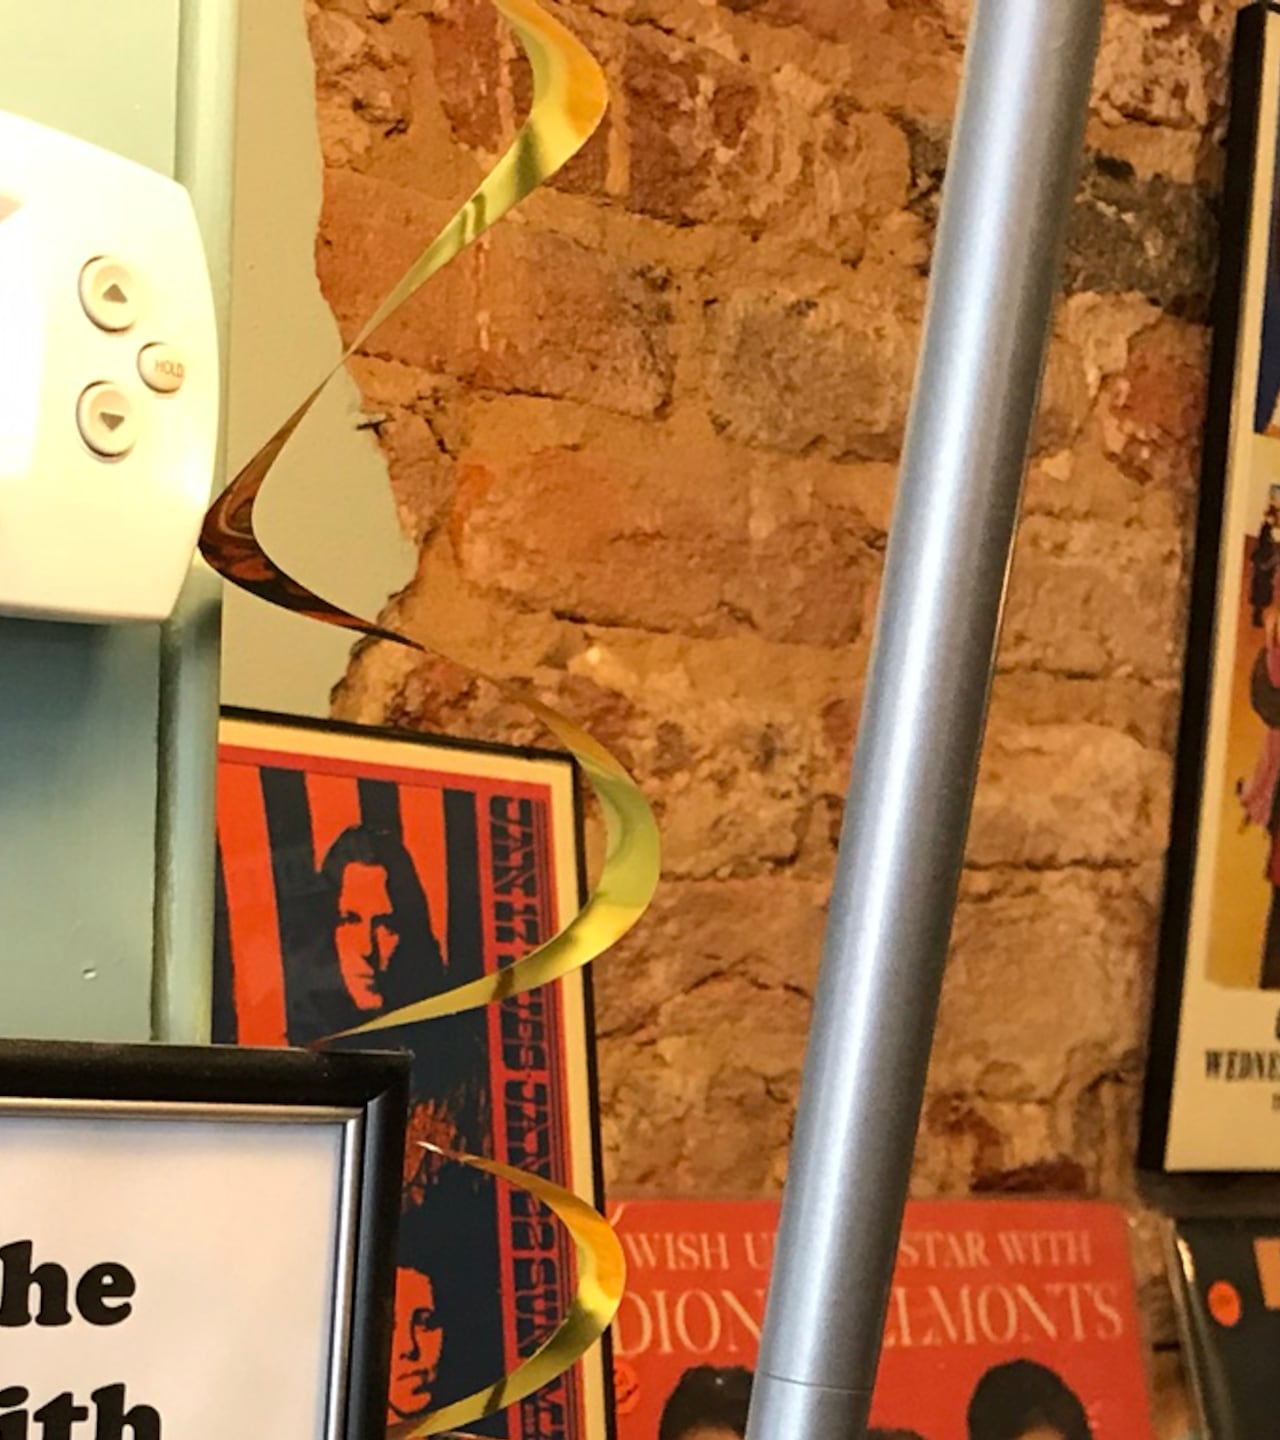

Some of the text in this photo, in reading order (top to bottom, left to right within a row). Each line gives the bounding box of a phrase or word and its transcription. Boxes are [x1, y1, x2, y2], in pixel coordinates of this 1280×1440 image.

[155, 359, 185, 379] HOLD
[624, 1231, 730, 1270] WISH
[997, 1230, 1092, 1267] WITH
[612, 1288, 766, 1358] DION
